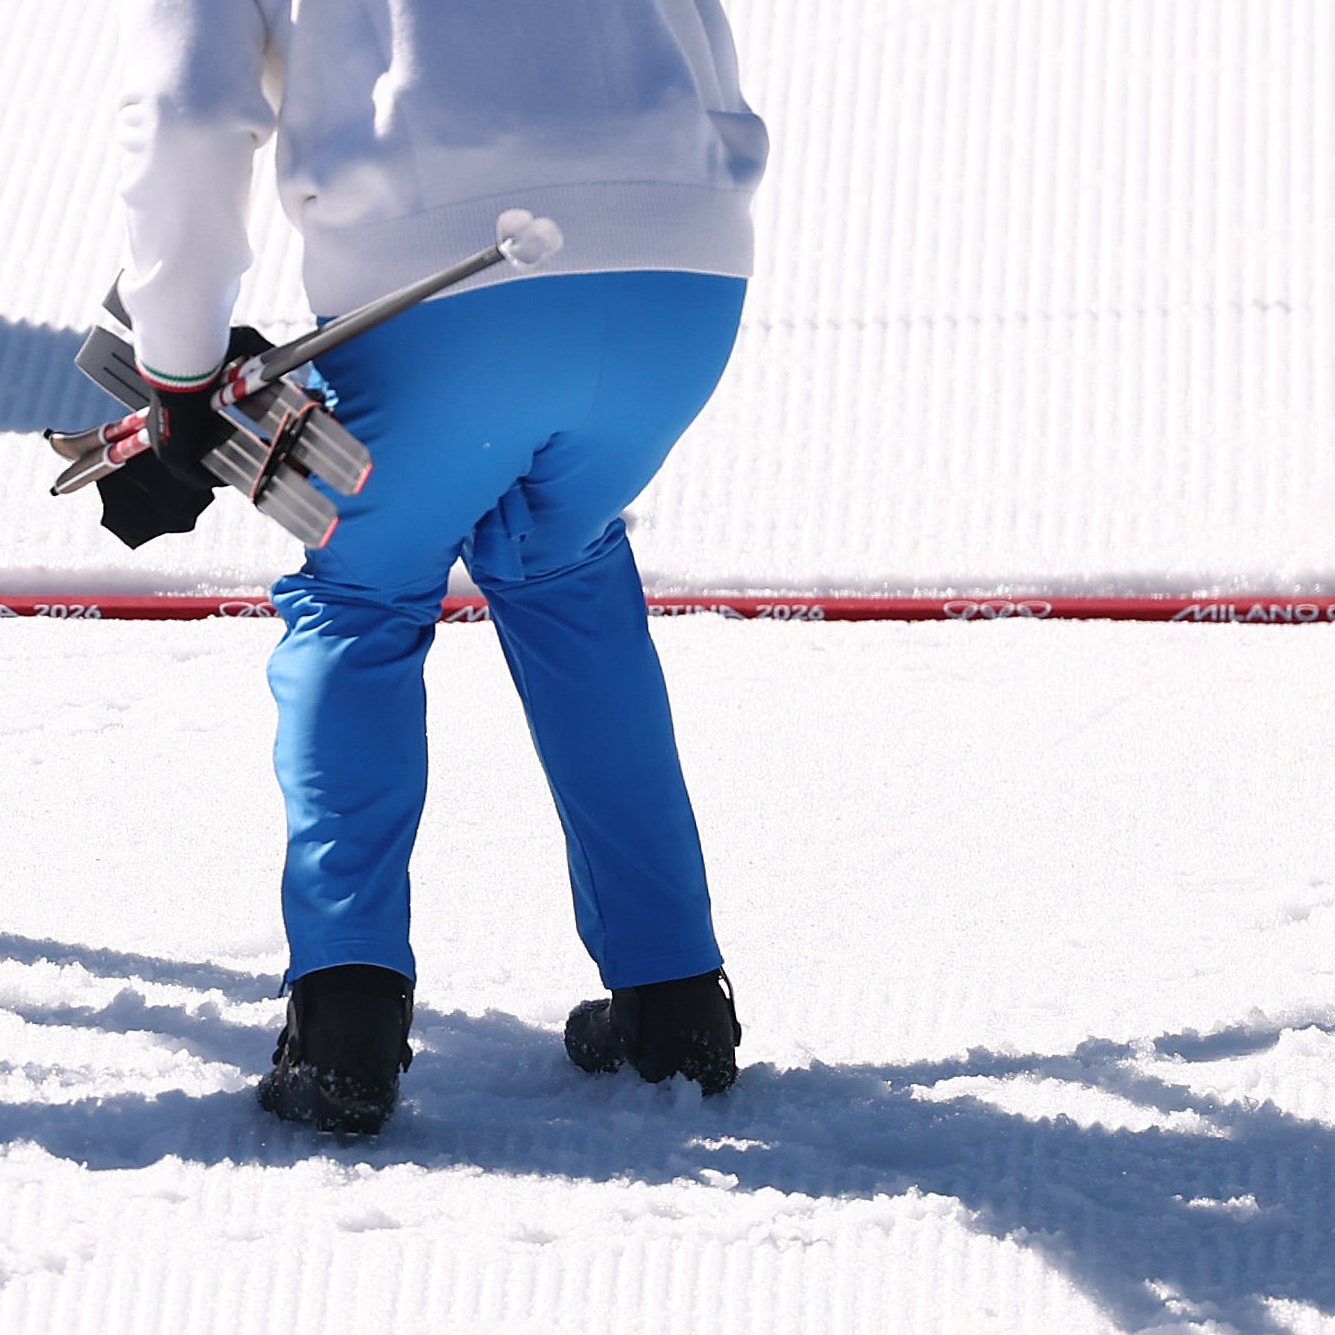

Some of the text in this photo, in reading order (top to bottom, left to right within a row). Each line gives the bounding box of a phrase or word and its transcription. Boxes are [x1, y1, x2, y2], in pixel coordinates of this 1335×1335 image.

[33, 604, 102, 619] 2026
[755, 604, 826, 621] 2026
[1171, 604, 1320, 622] MILANO
